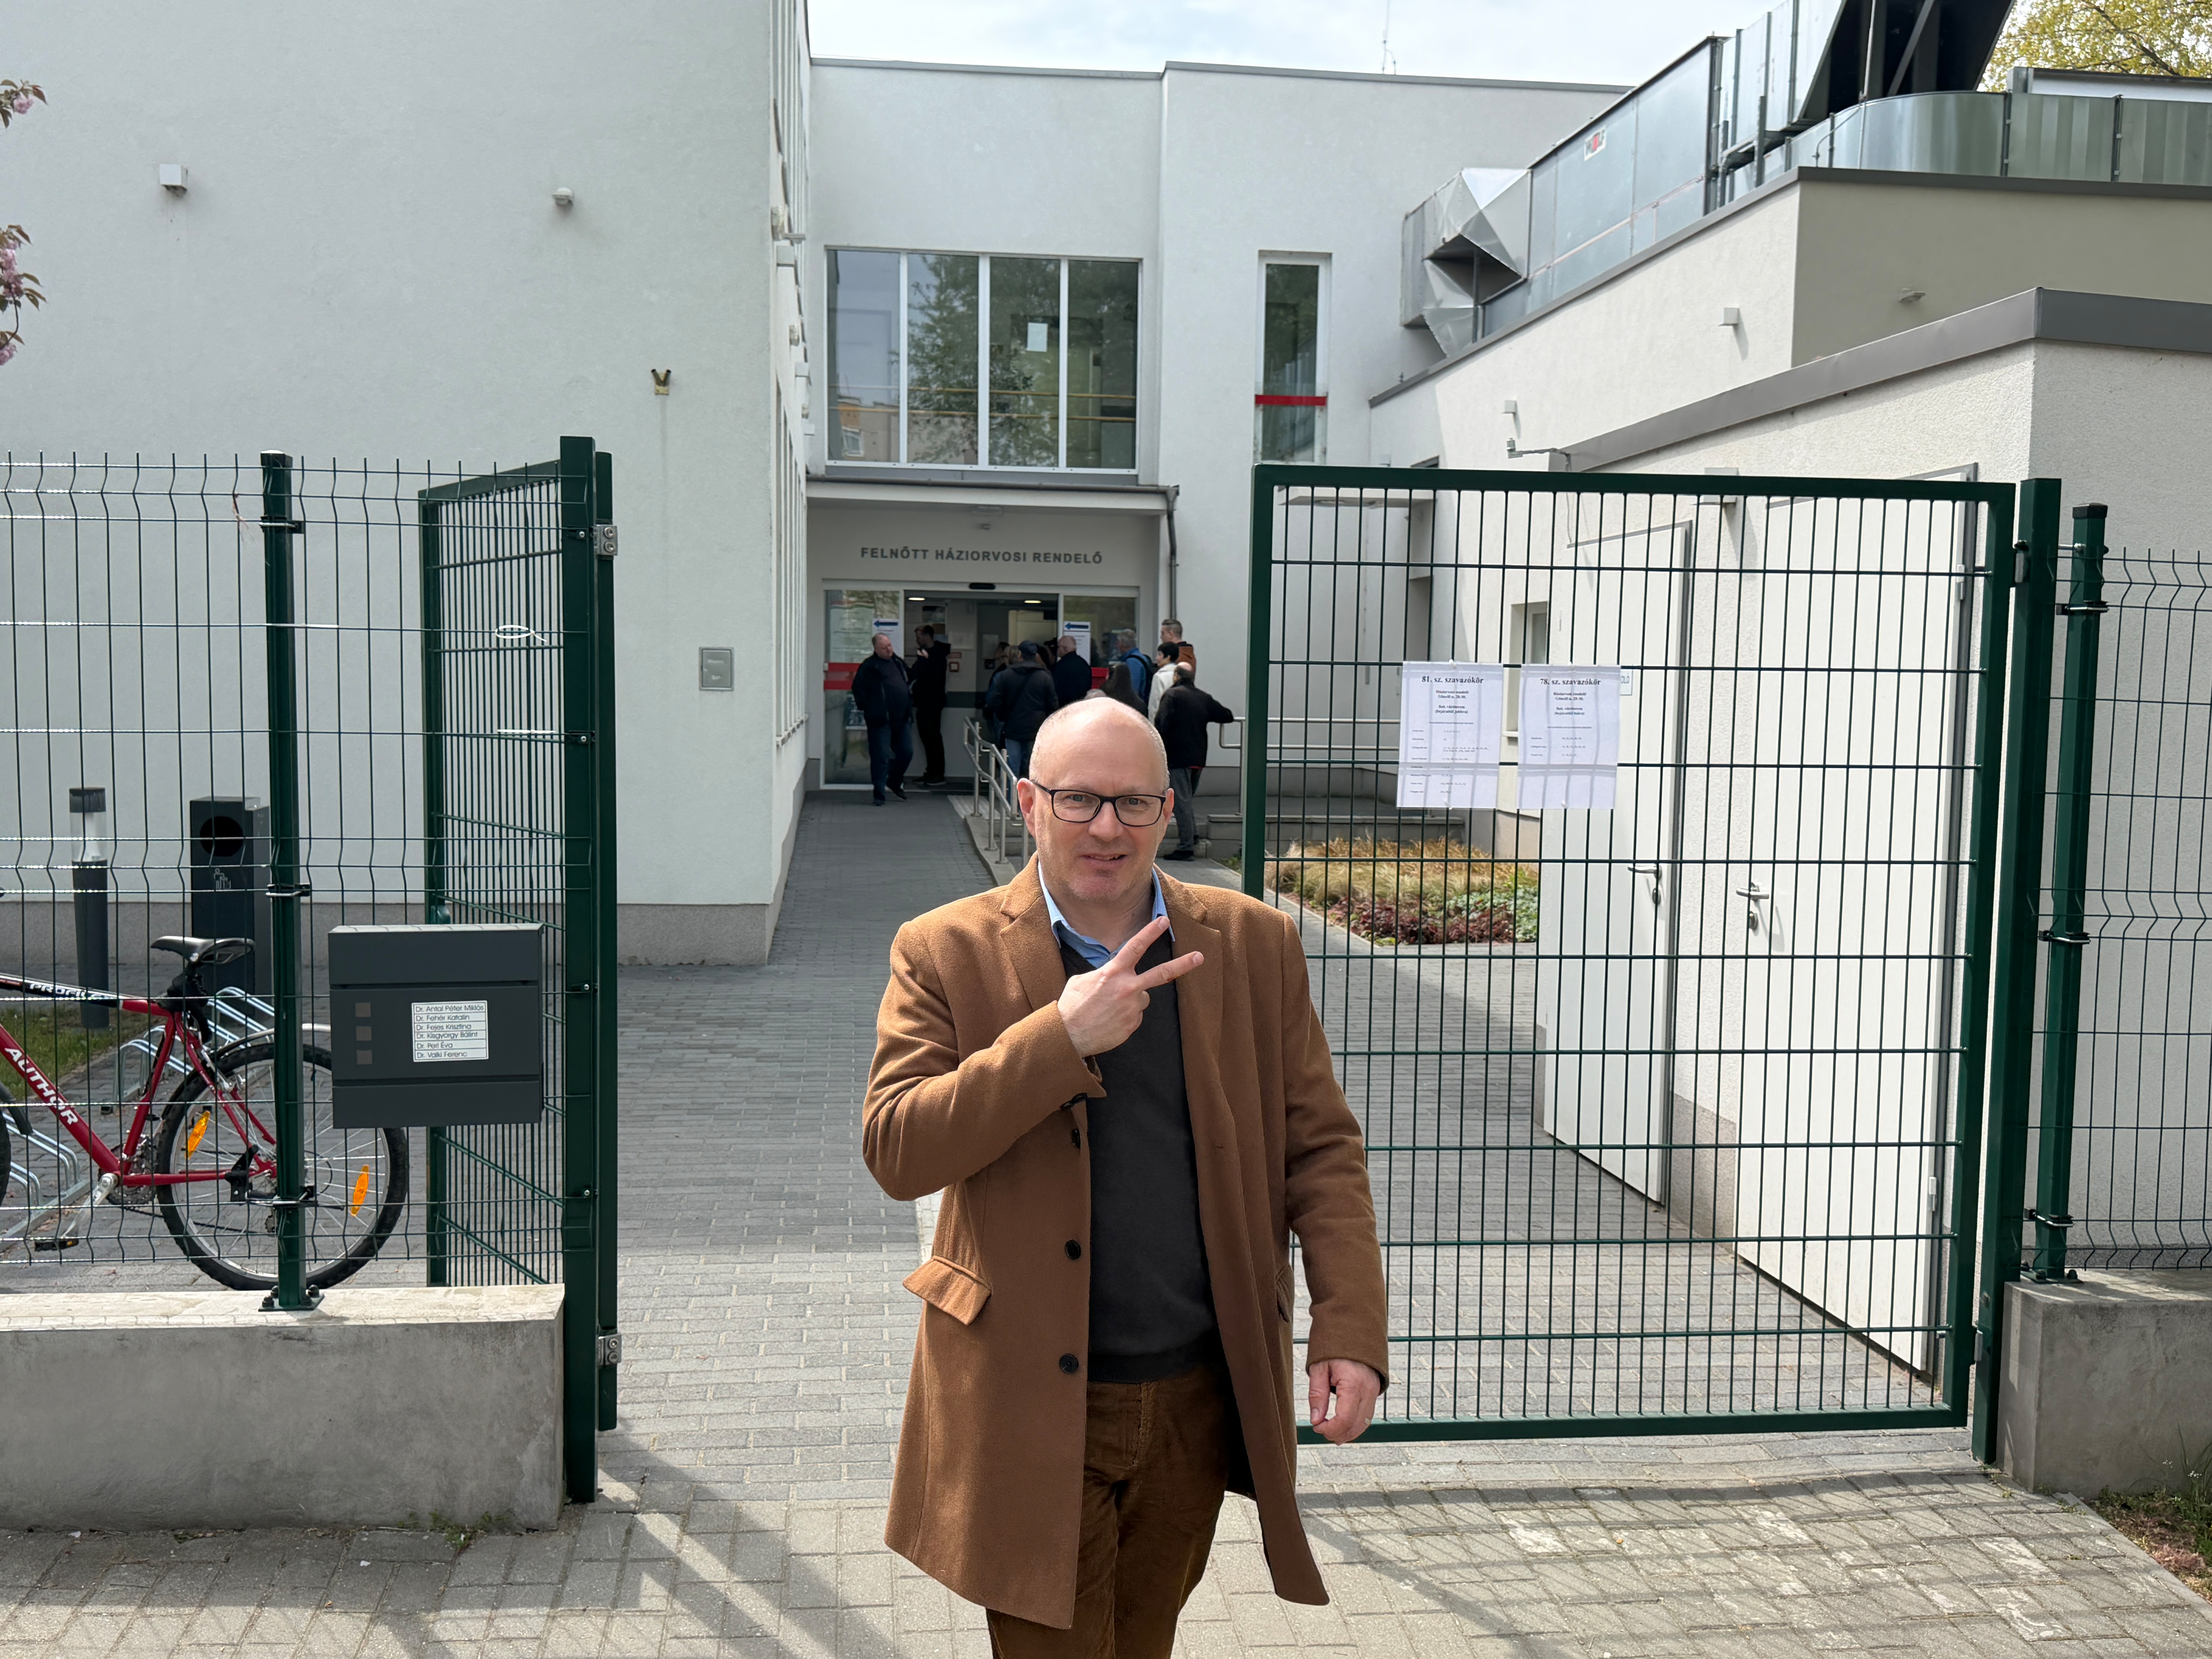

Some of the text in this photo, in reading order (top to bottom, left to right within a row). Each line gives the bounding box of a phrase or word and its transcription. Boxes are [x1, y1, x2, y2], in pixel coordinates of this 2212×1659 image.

[860, 546, 1103, 564] FELNŐTT HÁZIORVOSI RENDELŐ
[4, 1048, 78, 1125] AUTHOR
